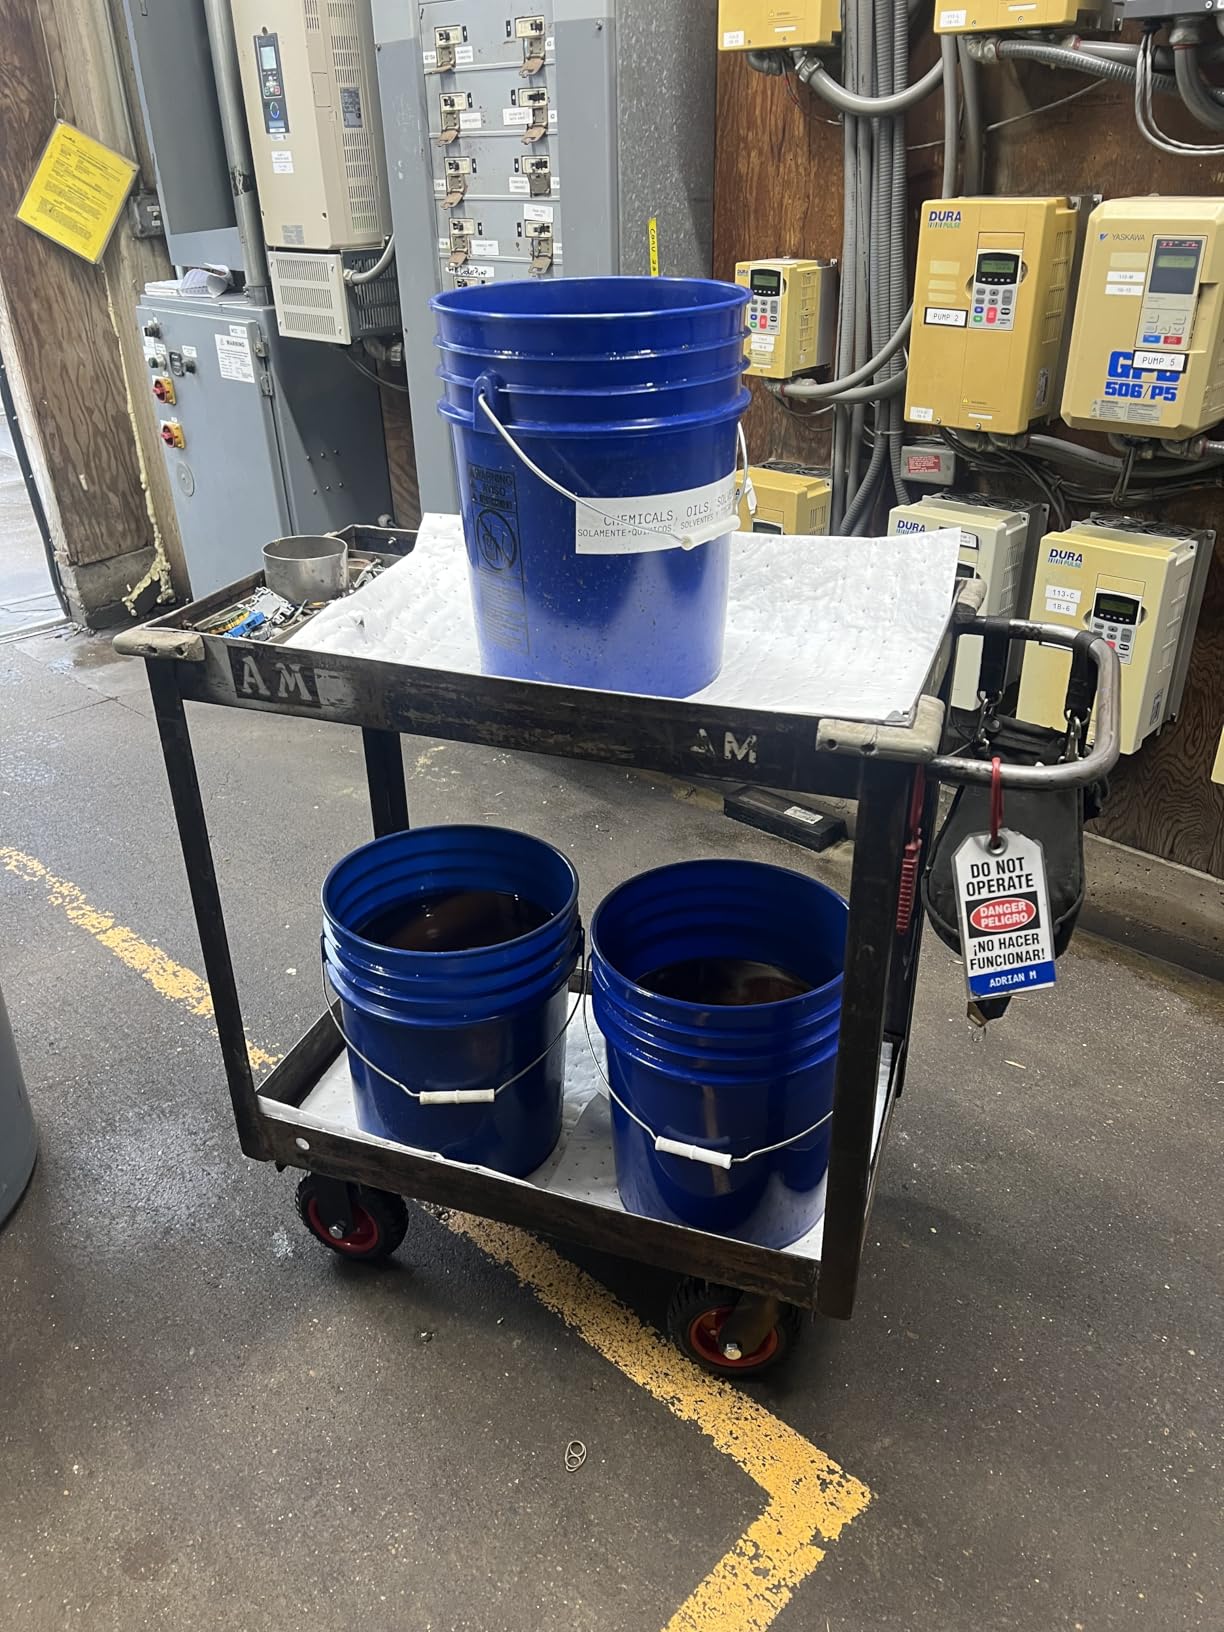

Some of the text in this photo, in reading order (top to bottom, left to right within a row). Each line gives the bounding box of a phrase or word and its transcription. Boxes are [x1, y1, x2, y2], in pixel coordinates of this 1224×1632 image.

[929, 211, 961, 222] DURA
[1112, 233, 1146, 242] YASKAWA
[933, 312, 960, 323] PUMP 2
[1142, 355, 1176, 367] PUMP 5
[1104, 381, 1179, 403] 506/P5
[680, 514, 714, 530] SOLVENTES
[897, 519, 926, 533] DURA
[1049, 548, 1083, 563] DURA
[1052, 588, 1076, 600] 113-C
[971, 857, 1025, 878] DO NOT
[966, 873, 1034, 896] OPERATE
[980, 901, 1027, 918] DANGER
[981, 912, 1028, 928] PELIGRO
[973, 933, 1040, 957] ¡NO HACER
[970, 948, 1046, 971] FUNCIONAR!
[990, 970, 1037, 988] ADRIAN M
